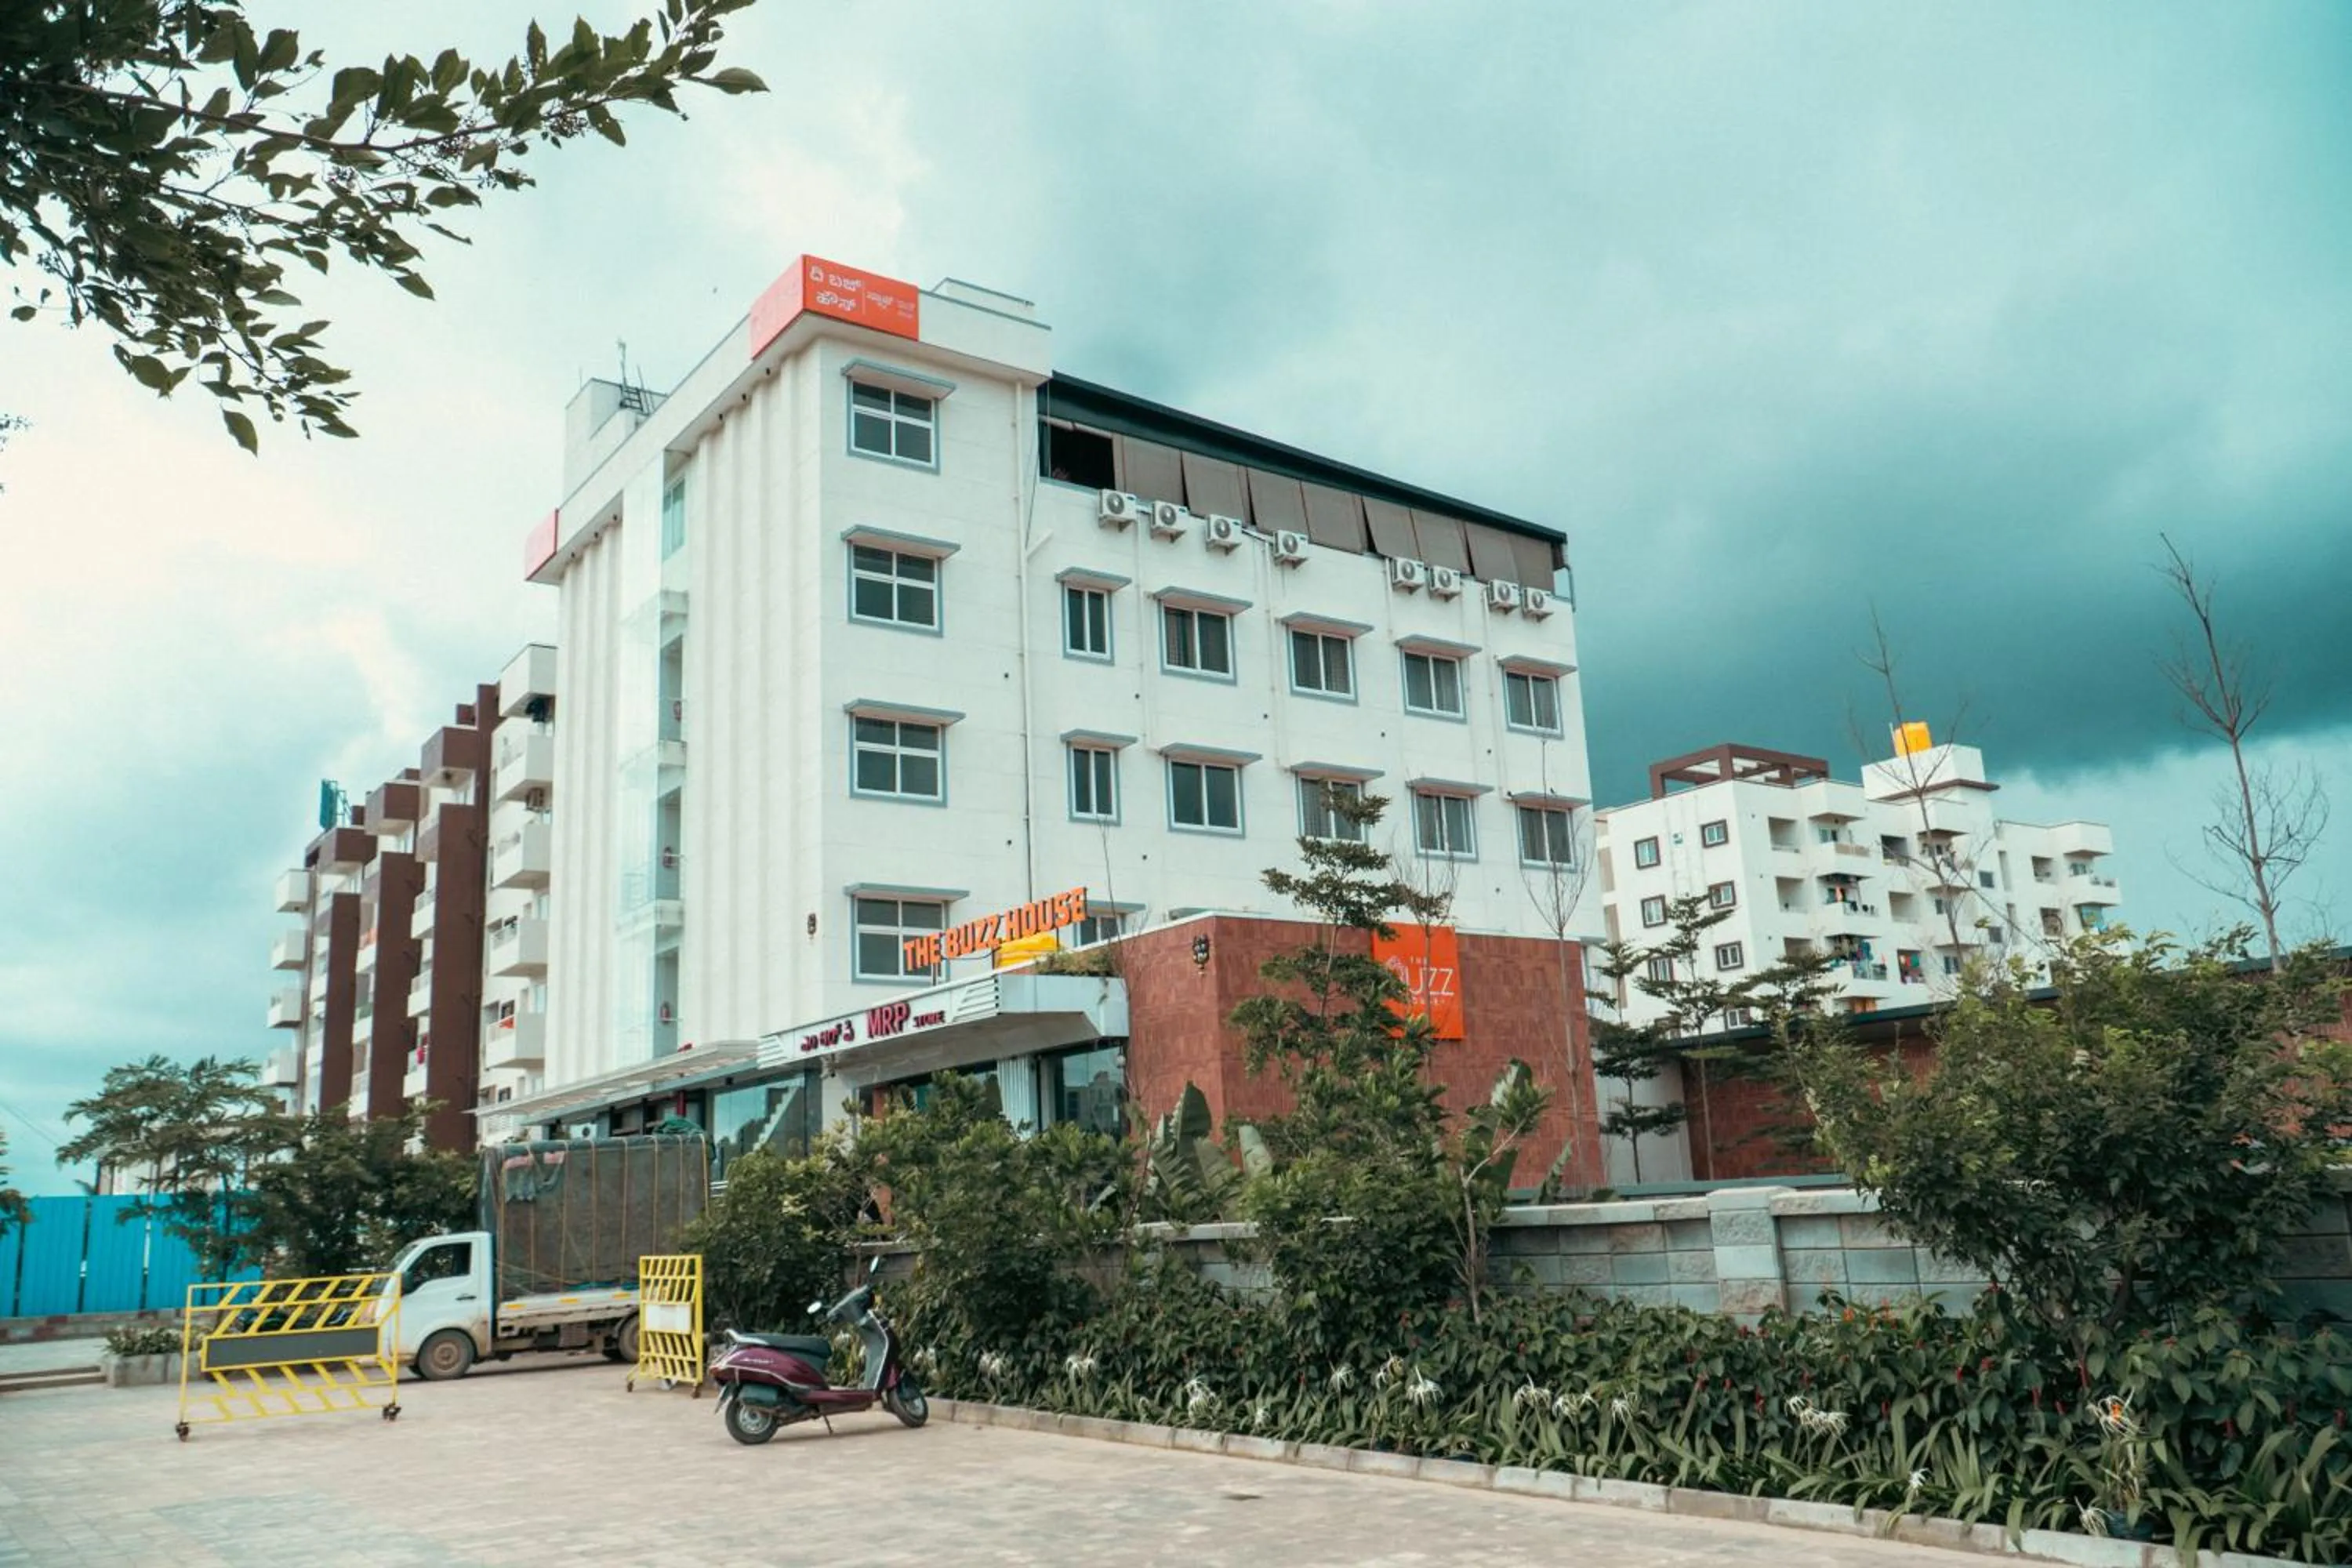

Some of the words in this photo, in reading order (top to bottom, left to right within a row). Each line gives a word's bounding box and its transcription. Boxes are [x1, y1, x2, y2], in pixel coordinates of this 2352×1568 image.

[903, 933, 942, 971] THE
[945, 914, 1001, 959] BUZZ
[1005, 887, 1088, 942] HOUSE
[867, 1002, 911, 1039] MRP
